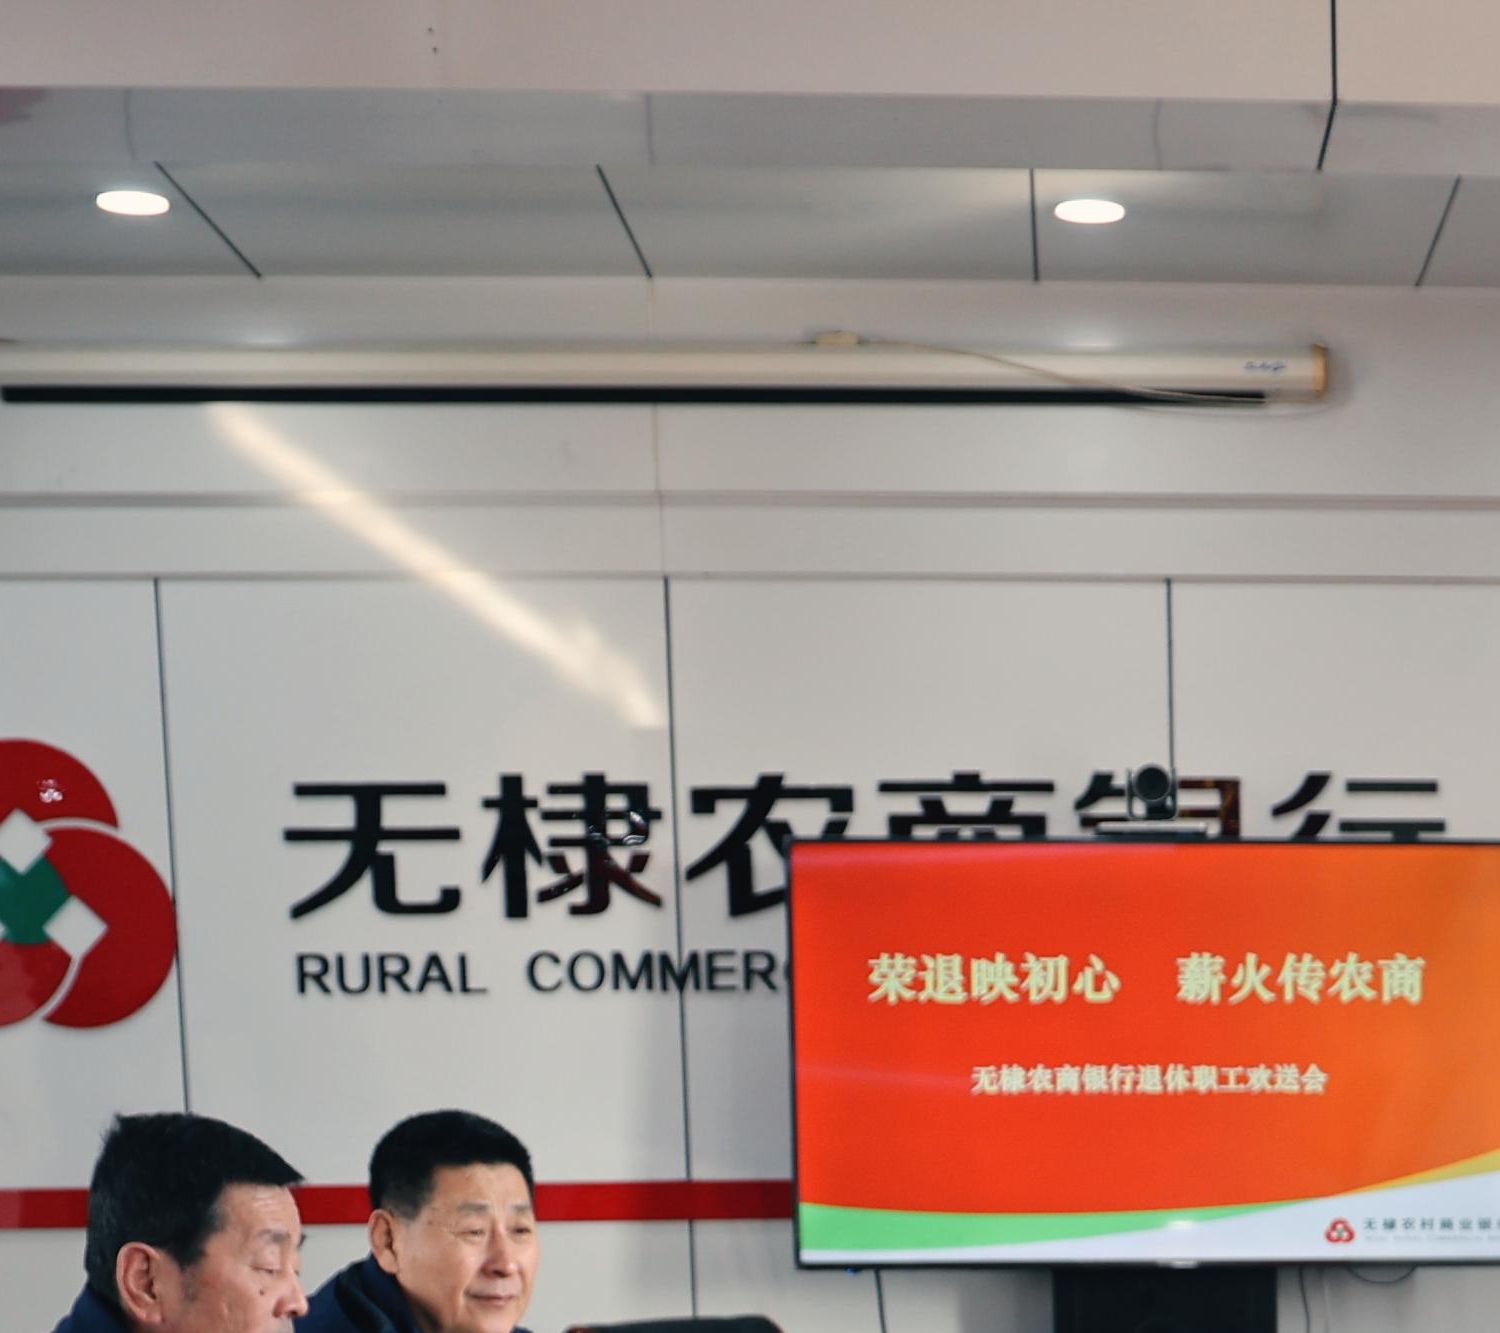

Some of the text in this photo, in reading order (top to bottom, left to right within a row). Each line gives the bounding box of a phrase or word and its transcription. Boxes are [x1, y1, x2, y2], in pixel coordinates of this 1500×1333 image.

[297, 950, 790, 994] RURAL COMMER
[868, 952, 1426, 1005] 荣退映初心 薪火传农商
[971, 1064, 1328, 1096] 无棣农商银行退休职工欢送会
